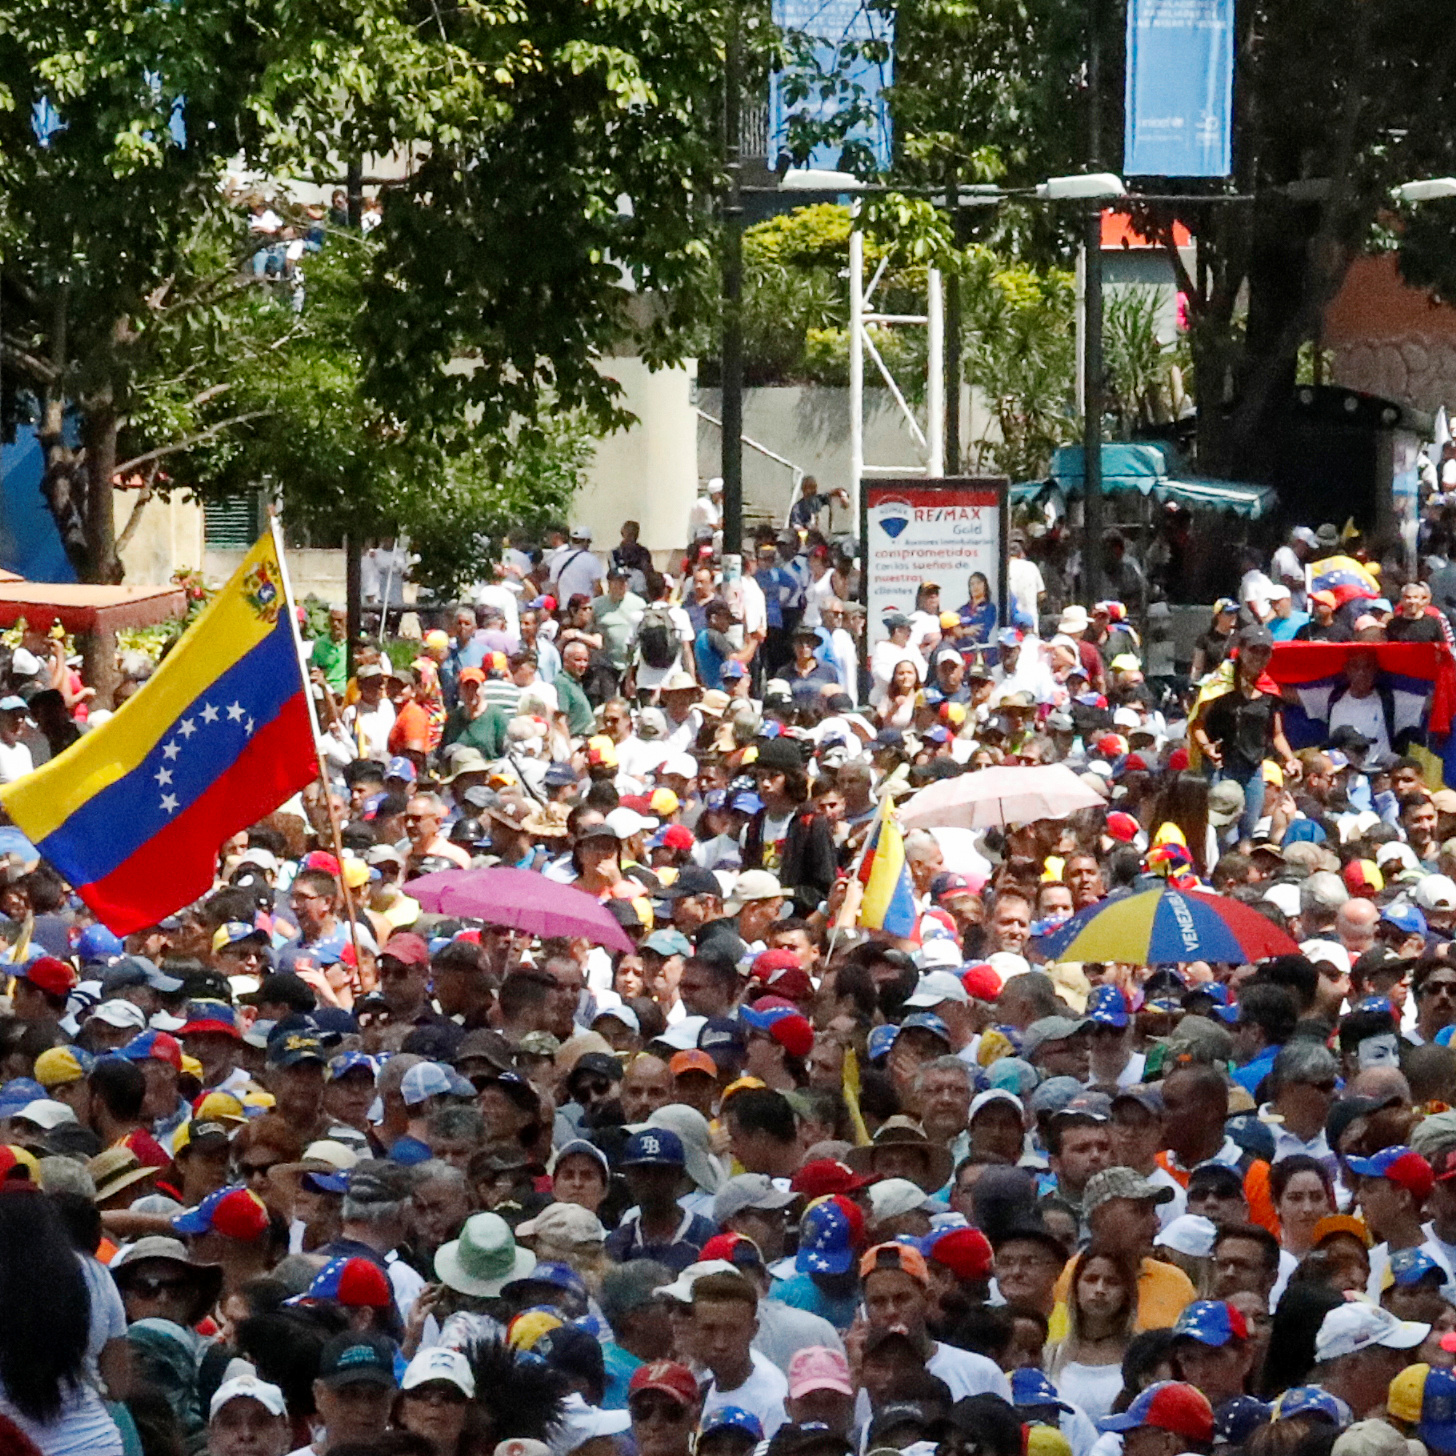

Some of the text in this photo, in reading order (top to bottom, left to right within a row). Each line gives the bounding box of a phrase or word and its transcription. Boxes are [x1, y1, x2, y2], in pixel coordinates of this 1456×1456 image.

[914, 508, 981, 522] RE/MAX
[953, 525, 982, 535] Gold
[875, 549, 979, 560] comprometidos
